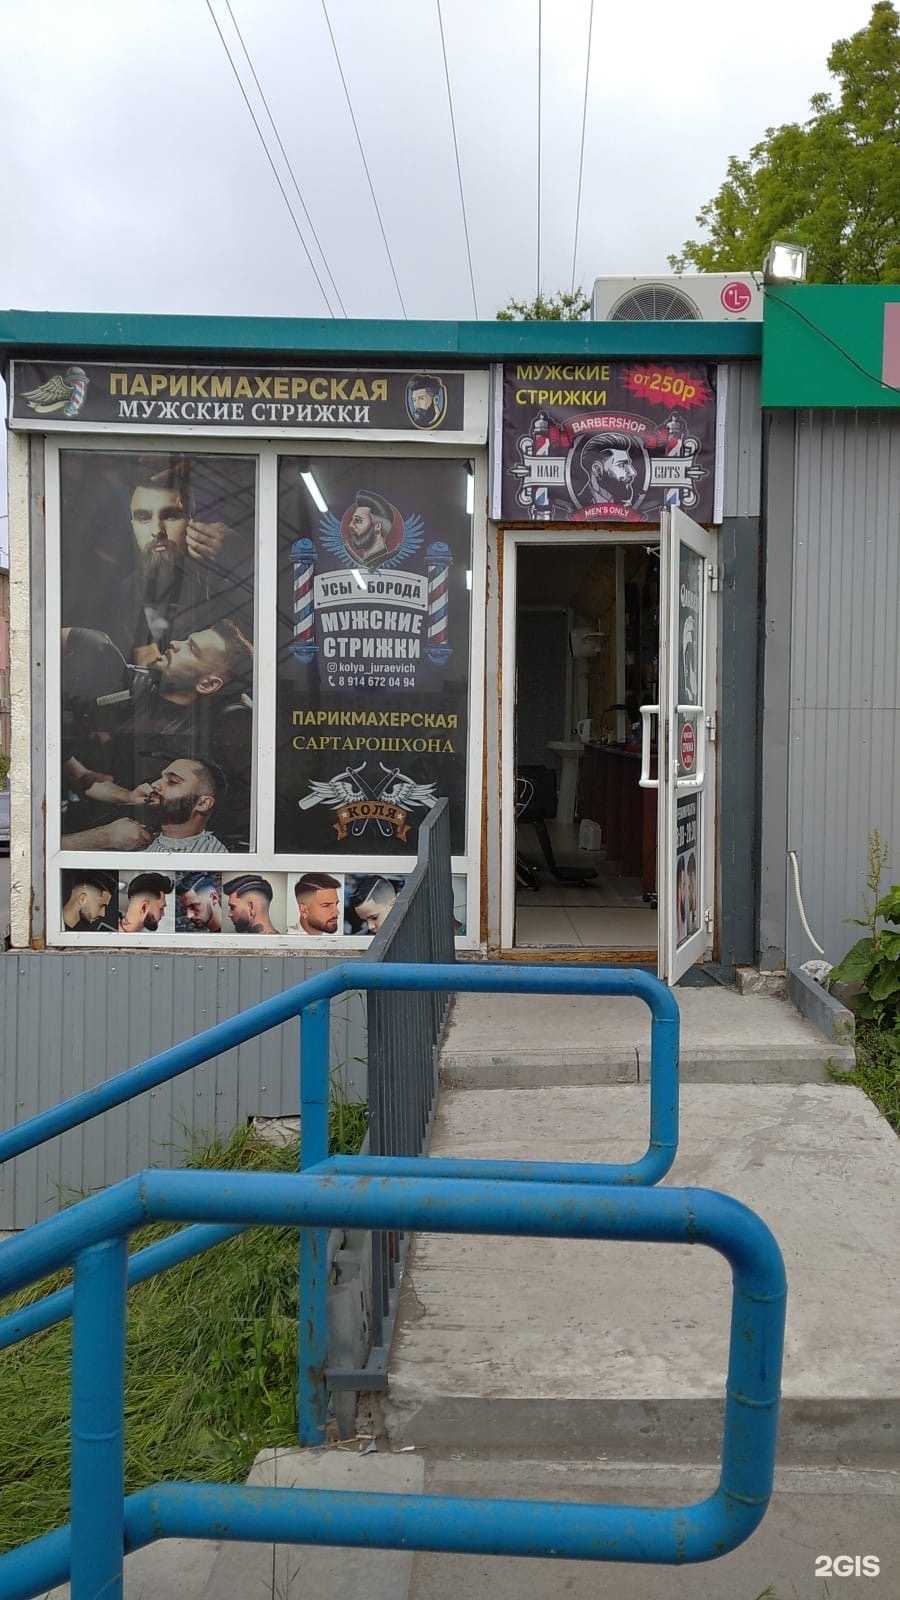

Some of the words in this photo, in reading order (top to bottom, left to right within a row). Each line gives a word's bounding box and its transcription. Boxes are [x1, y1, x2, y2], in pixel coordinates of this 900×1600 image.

[516, 366, 610, 381] МУЖСКИЕ
[109, 373, 388, 401] ПАРИКМАХЕРСКАЯ
[515, 389, 607, 406] СТРИЖКИ
[118, 401, 244, 421] МУЖСКИЕ
[251, 404, 370, 423] СТРИЖКИ
[571, 417, 647, 433] BARBERSHOP
[584, 506, 609, 516] MEN'S
[609, 506, 630, 516] ONLY
[321, 581, 352, 597] УСЫ
[367, 581, 421, 599] БОРОДА
[320, 610, 423, 634] МУЖСКИЕ
[323, 637, 421, 658] СТРИЖКИ
[338, 676, 345, 687] 8
[347, 676, 365, 687] 914
[368, 677, 386, 688] 672
[388, 677, 400, 689] 04
[403, 677, 415, 689] 94
[292, 711, 458, 728] ПАРИКМАХЕРСКАЯ
[292, 736, 455, 753] САРТАРОШХОНА
[348, 804, 397, 819] КОЛЯ
